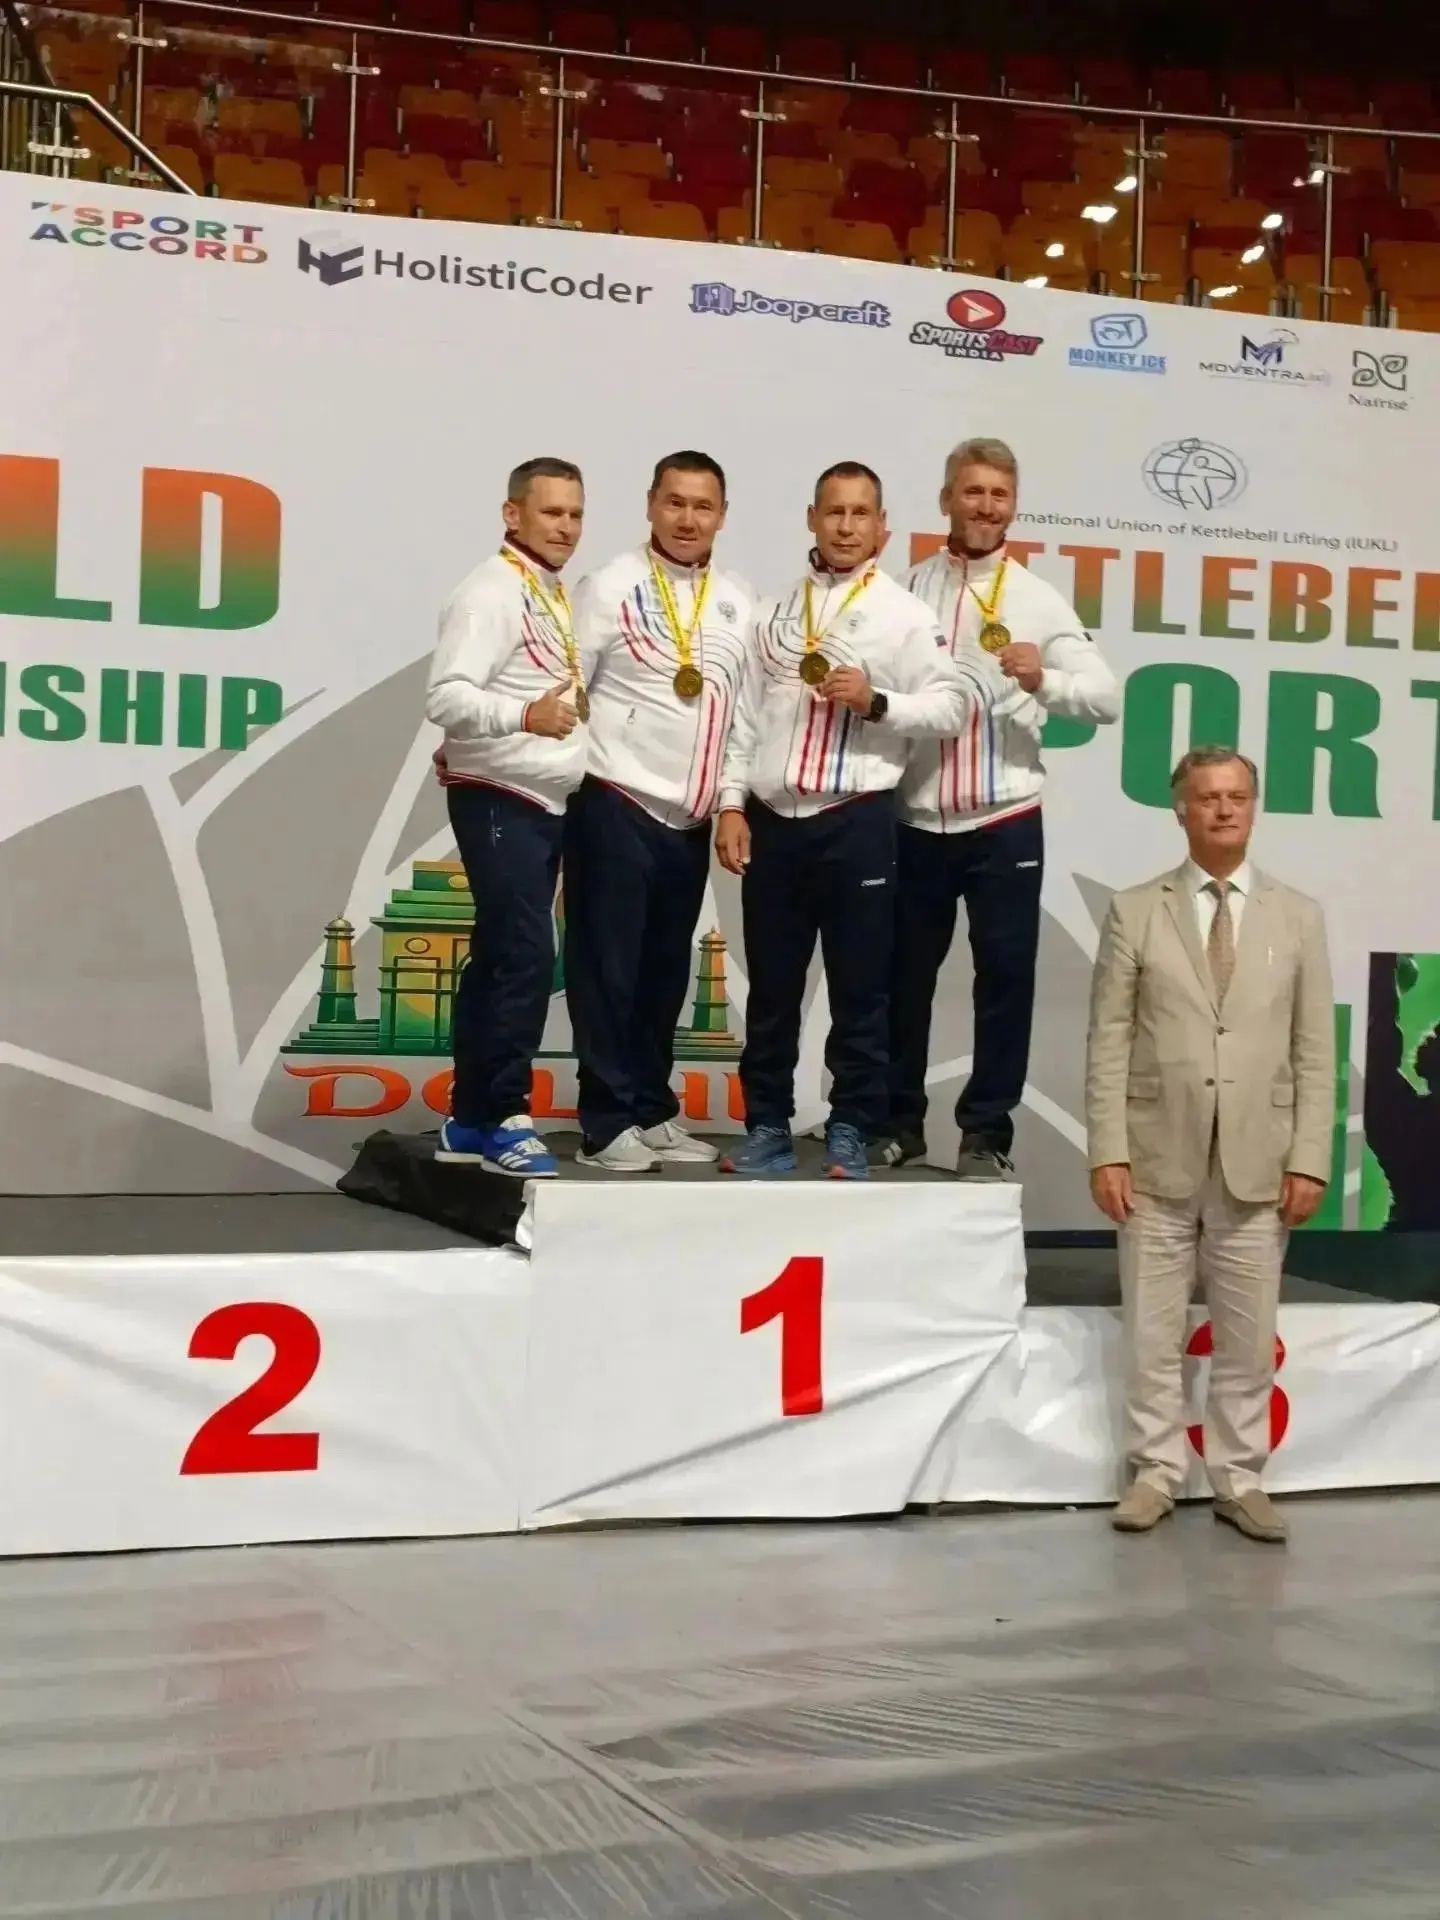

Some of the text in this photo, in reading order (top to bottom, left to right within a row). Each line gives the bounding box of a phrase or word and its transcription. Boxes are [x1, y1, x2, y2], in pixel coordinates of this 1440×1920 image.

[29, 223, 269, 264] ACCORD
[73, 206, 264, 244] SPORT
[374, 247, 653, 305] HolistiCoder
[945, 346, 1004, 361] INDIA
[1069, 347, 1167, 374] MONKEY ICE
[1106, 516, 1163, 534] Union
[1168, 522, 1187, 535] of
[1191, 524, 1279, 543] Kettlebell
[1283, 531, 1341, 550] Lifting
[1345, 537, 1398, 553] (IUKL)
[0, 661, 284, 751] SHIP
[740, 1256, 823, 1416] 1
[179, 1302, 321, 1475] 2
